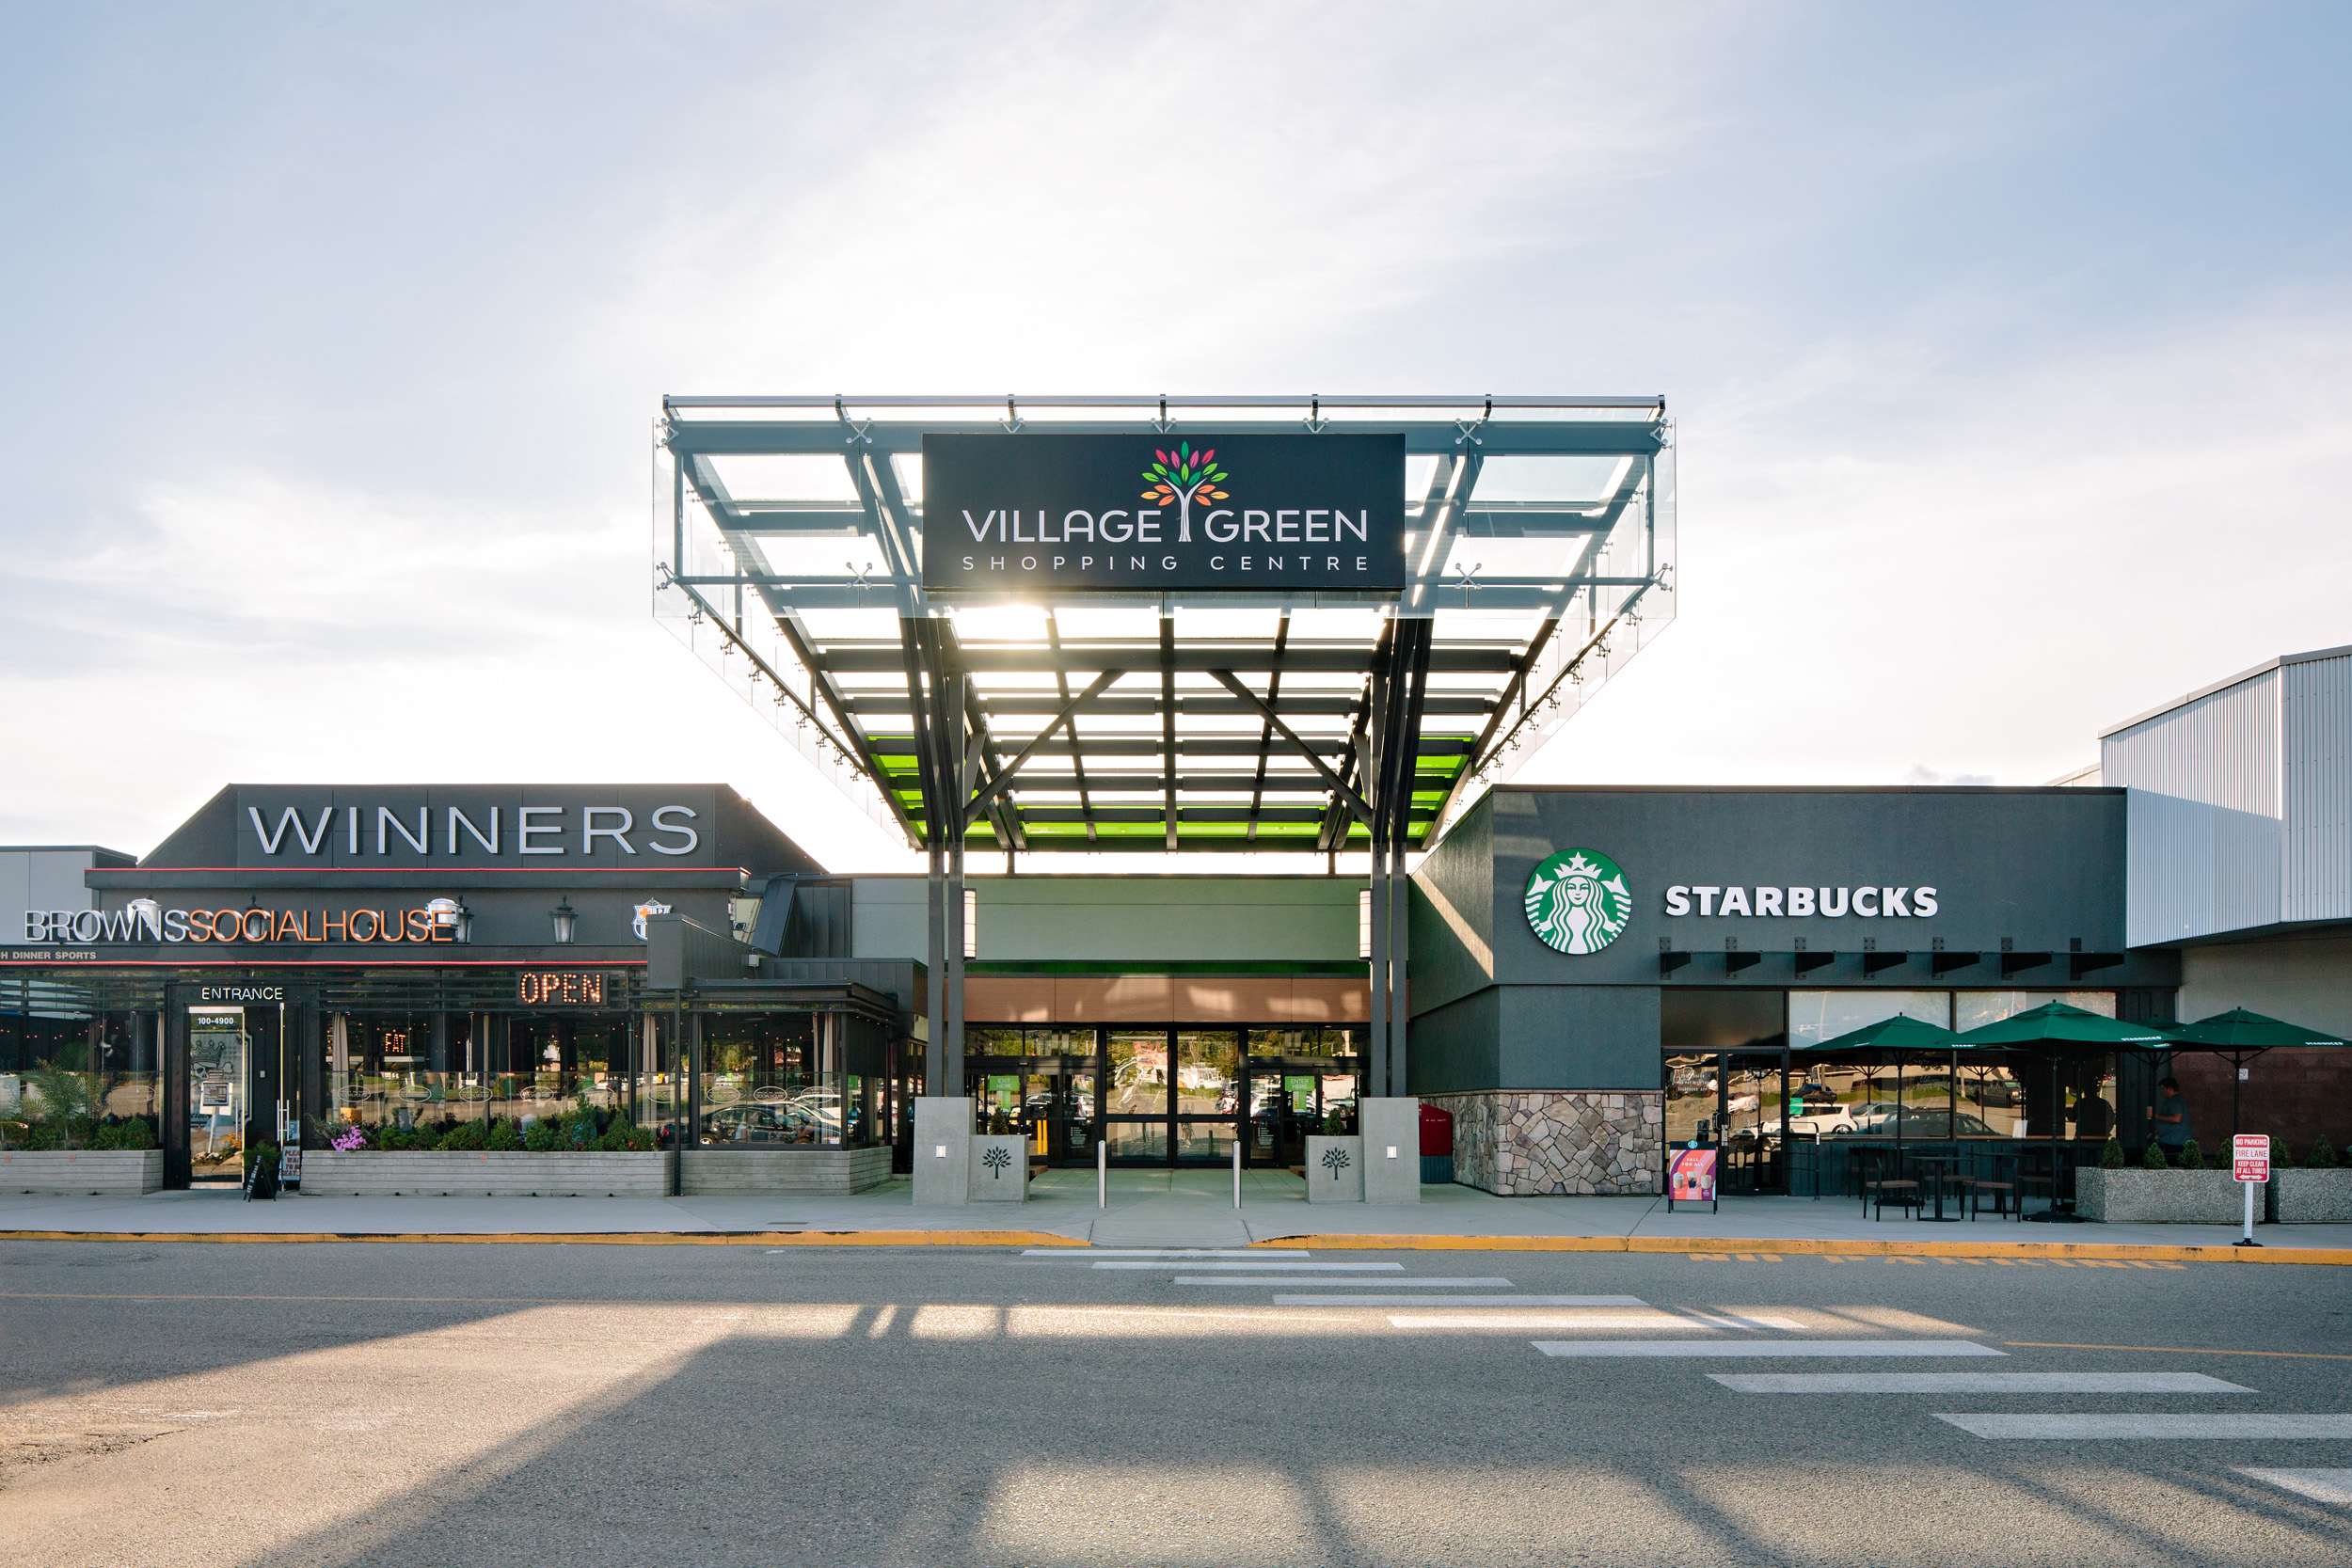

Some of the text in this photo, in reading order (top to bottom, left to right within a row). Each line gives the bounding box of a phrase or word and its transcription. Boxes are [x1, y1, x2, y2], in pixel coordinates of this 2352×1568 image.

[961, 509, 1367, 543] VILLAGE GREEN
[961, 555, 1367, 571] SHOPPING CENTRE
[247, 804, 699, 855] WINNERS
[1665, 885, 1938, 917] STARBUCKS
[12, 951, 52, 959] DINNER
[55, 951, 97, 959] SPORTS
[201, 987, 283, 1001] ENTRANCE
[519, 972, 601, 1004] OPEN
[197, 1017, 234, 1025] 100-4900
[2235, 1149, 2267, 1158] FIRE LANE
